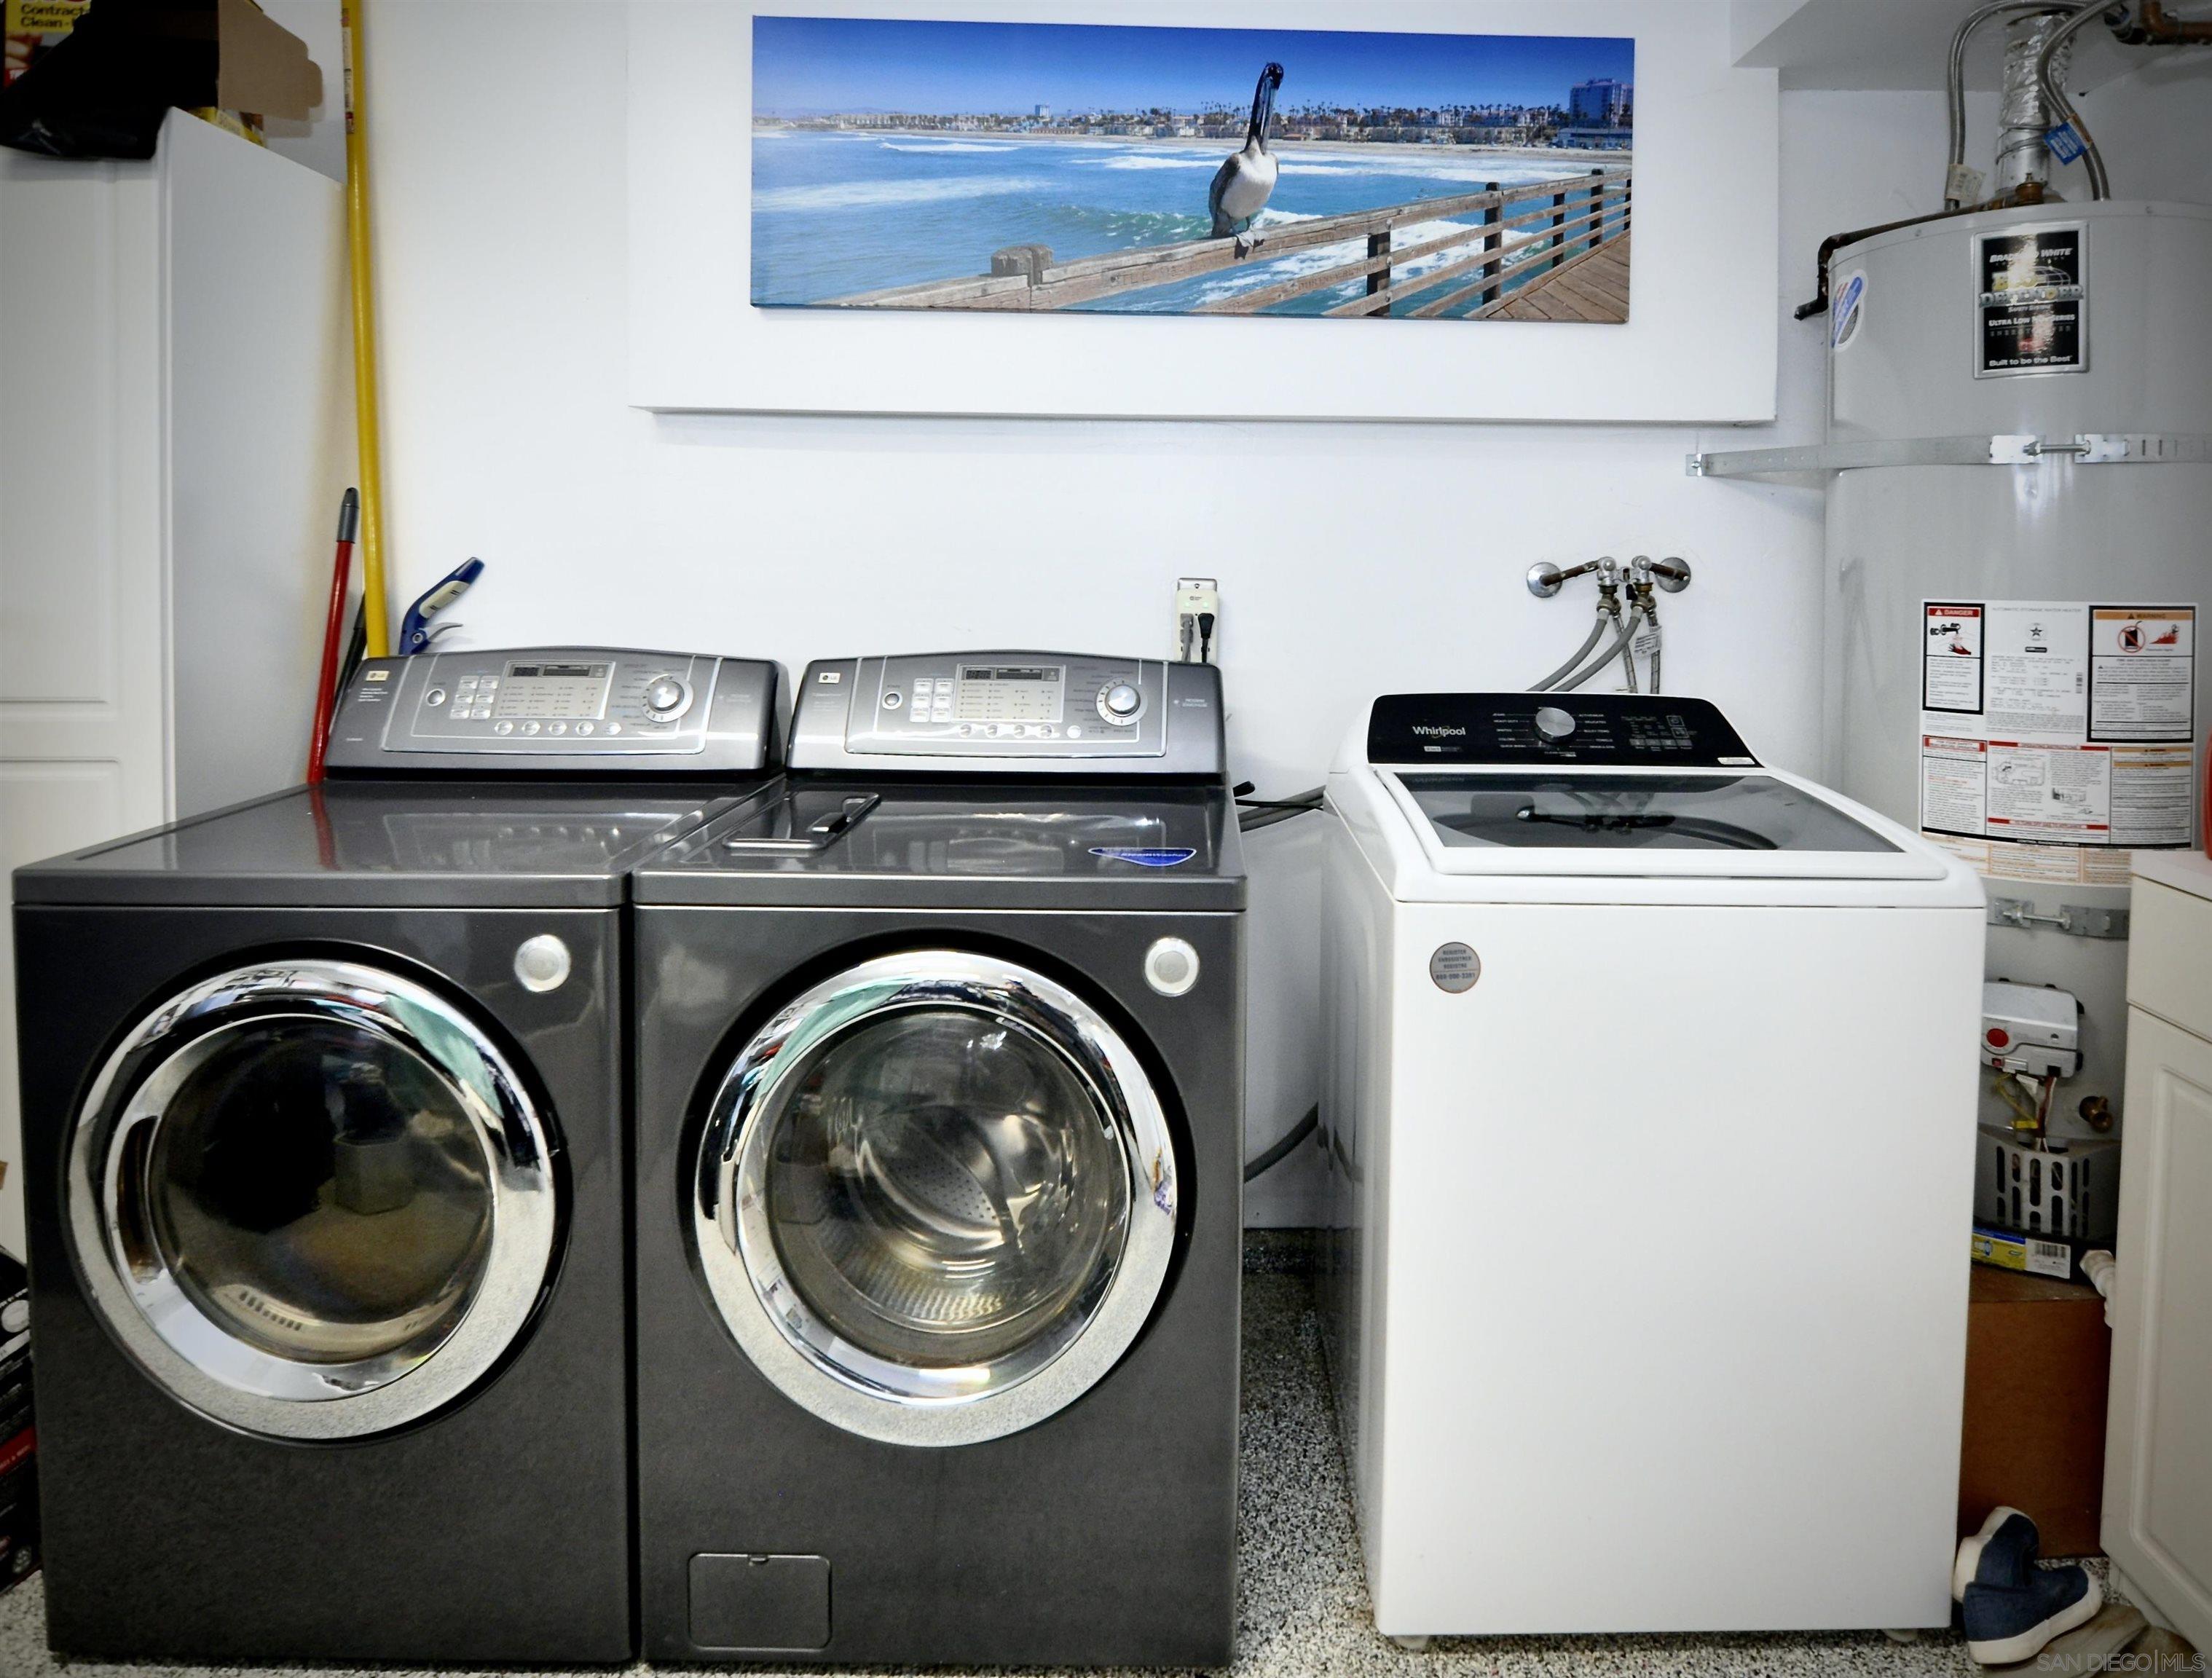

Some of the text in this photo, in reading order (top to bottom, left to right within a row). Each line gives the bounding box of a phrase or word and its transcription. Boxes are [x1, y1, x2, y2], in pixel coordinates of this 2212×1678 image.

[21, 4, 84, 15] Contract
[20, 16, 74, 28] Clean-
[2040, 248, 2073, 257] WHITE
[2013, 317, 2031, 325] LOW
[1944, 607, 1974, 615] DANGER
[1413, 726, 1466, 737] Whirlpool
